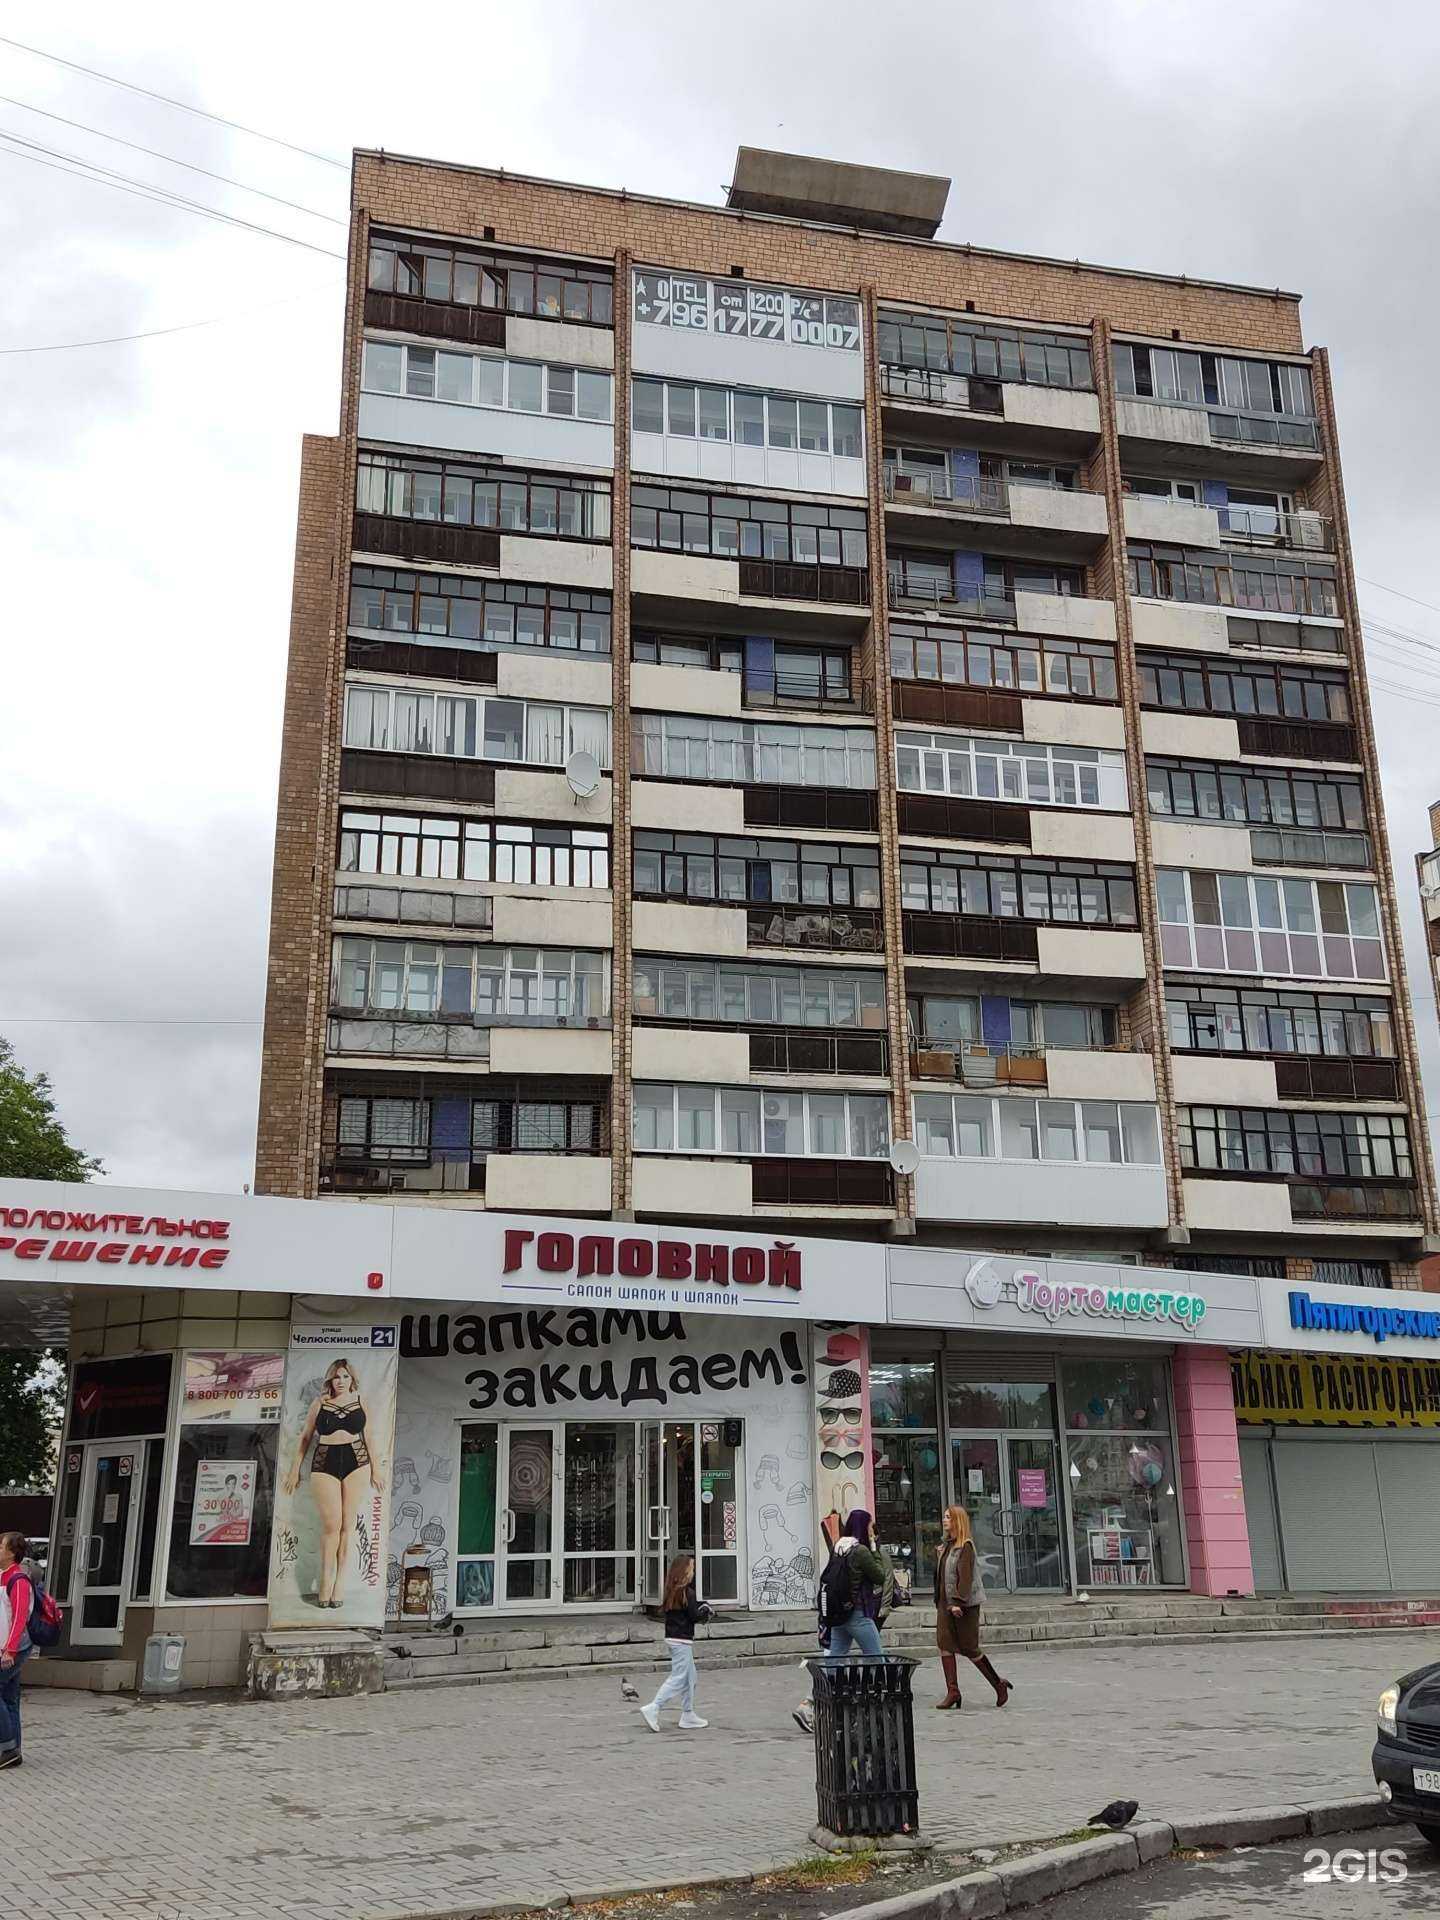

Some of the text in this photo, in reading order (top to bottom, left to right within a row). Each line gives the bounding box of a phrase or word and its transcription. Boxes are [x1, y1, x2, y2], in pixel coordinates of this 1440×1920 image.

[751, 291, 784, 314] 1200
[0, 1207, 231, 1240] ПОЛОЖИТЕЛЬНОЕ
[502, 1229, 802, 1291] ГОЛОВНОЙ
[567, 1284, 738, 1305] САЛОН ШАПОК И ШЛЯПОК
[1021, 1274, 1207, 1324] Тортомастер
[293, 1330, 393, 1345] Челюскинцев 21
[464, 1331, 807, 1409] закидаем!
